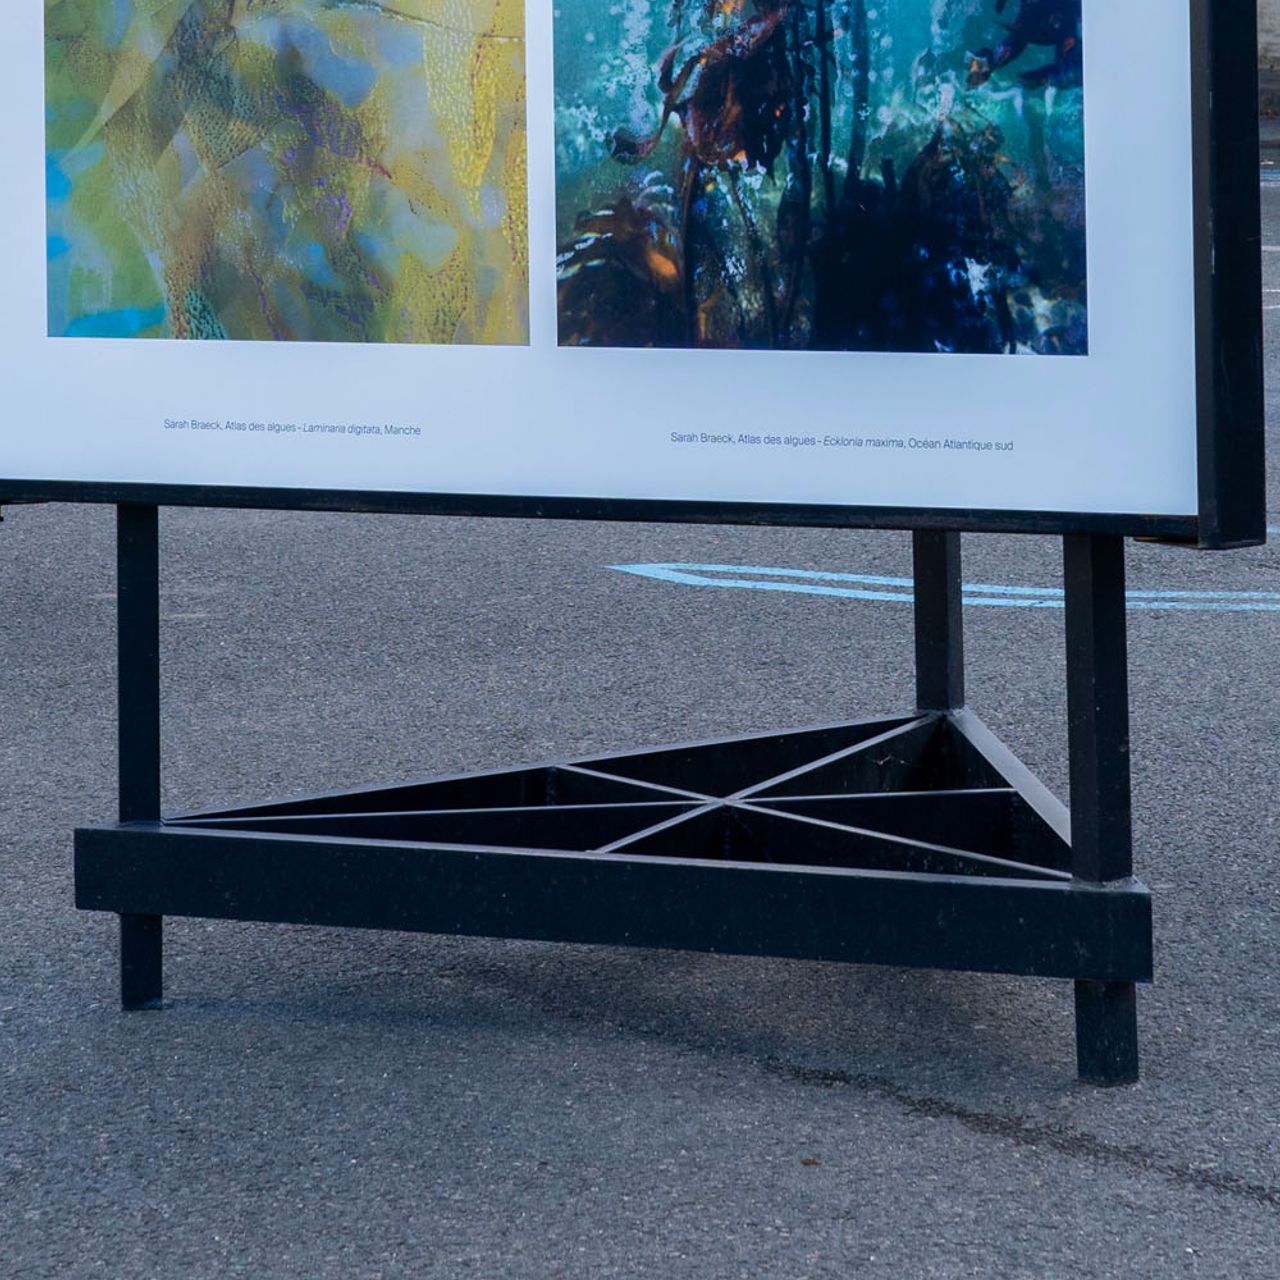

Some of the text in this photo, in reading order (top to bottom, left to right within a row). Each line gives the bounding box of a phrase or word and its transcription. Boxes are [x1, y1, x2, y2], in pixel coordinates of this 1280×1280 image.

[164, 419, 189, 429] Sarah
[191, 420, 223, 431] Braeck,
[225, 421, 246, 431] Atlas
[249, 421, 264, 431] des
[268, 422, 296, 433] algues
[303, 423, 345, 433] Laminaria
[385, 425, 420, 435] Manche
[671, 432, 698, 442] Sarah
[701, 433, 735, 444] Braeck,
[738, 434, 761, 444] Atlas
[764, 435, 782, 445] des
[784, 435, 815, 448] algues
[823, 436, 863, 447] Ecklonia
[866, 437, 906, 449] maxima,
[944, 439, 992, 452] Atlantique
[995, 440, 1013, 451] sud
